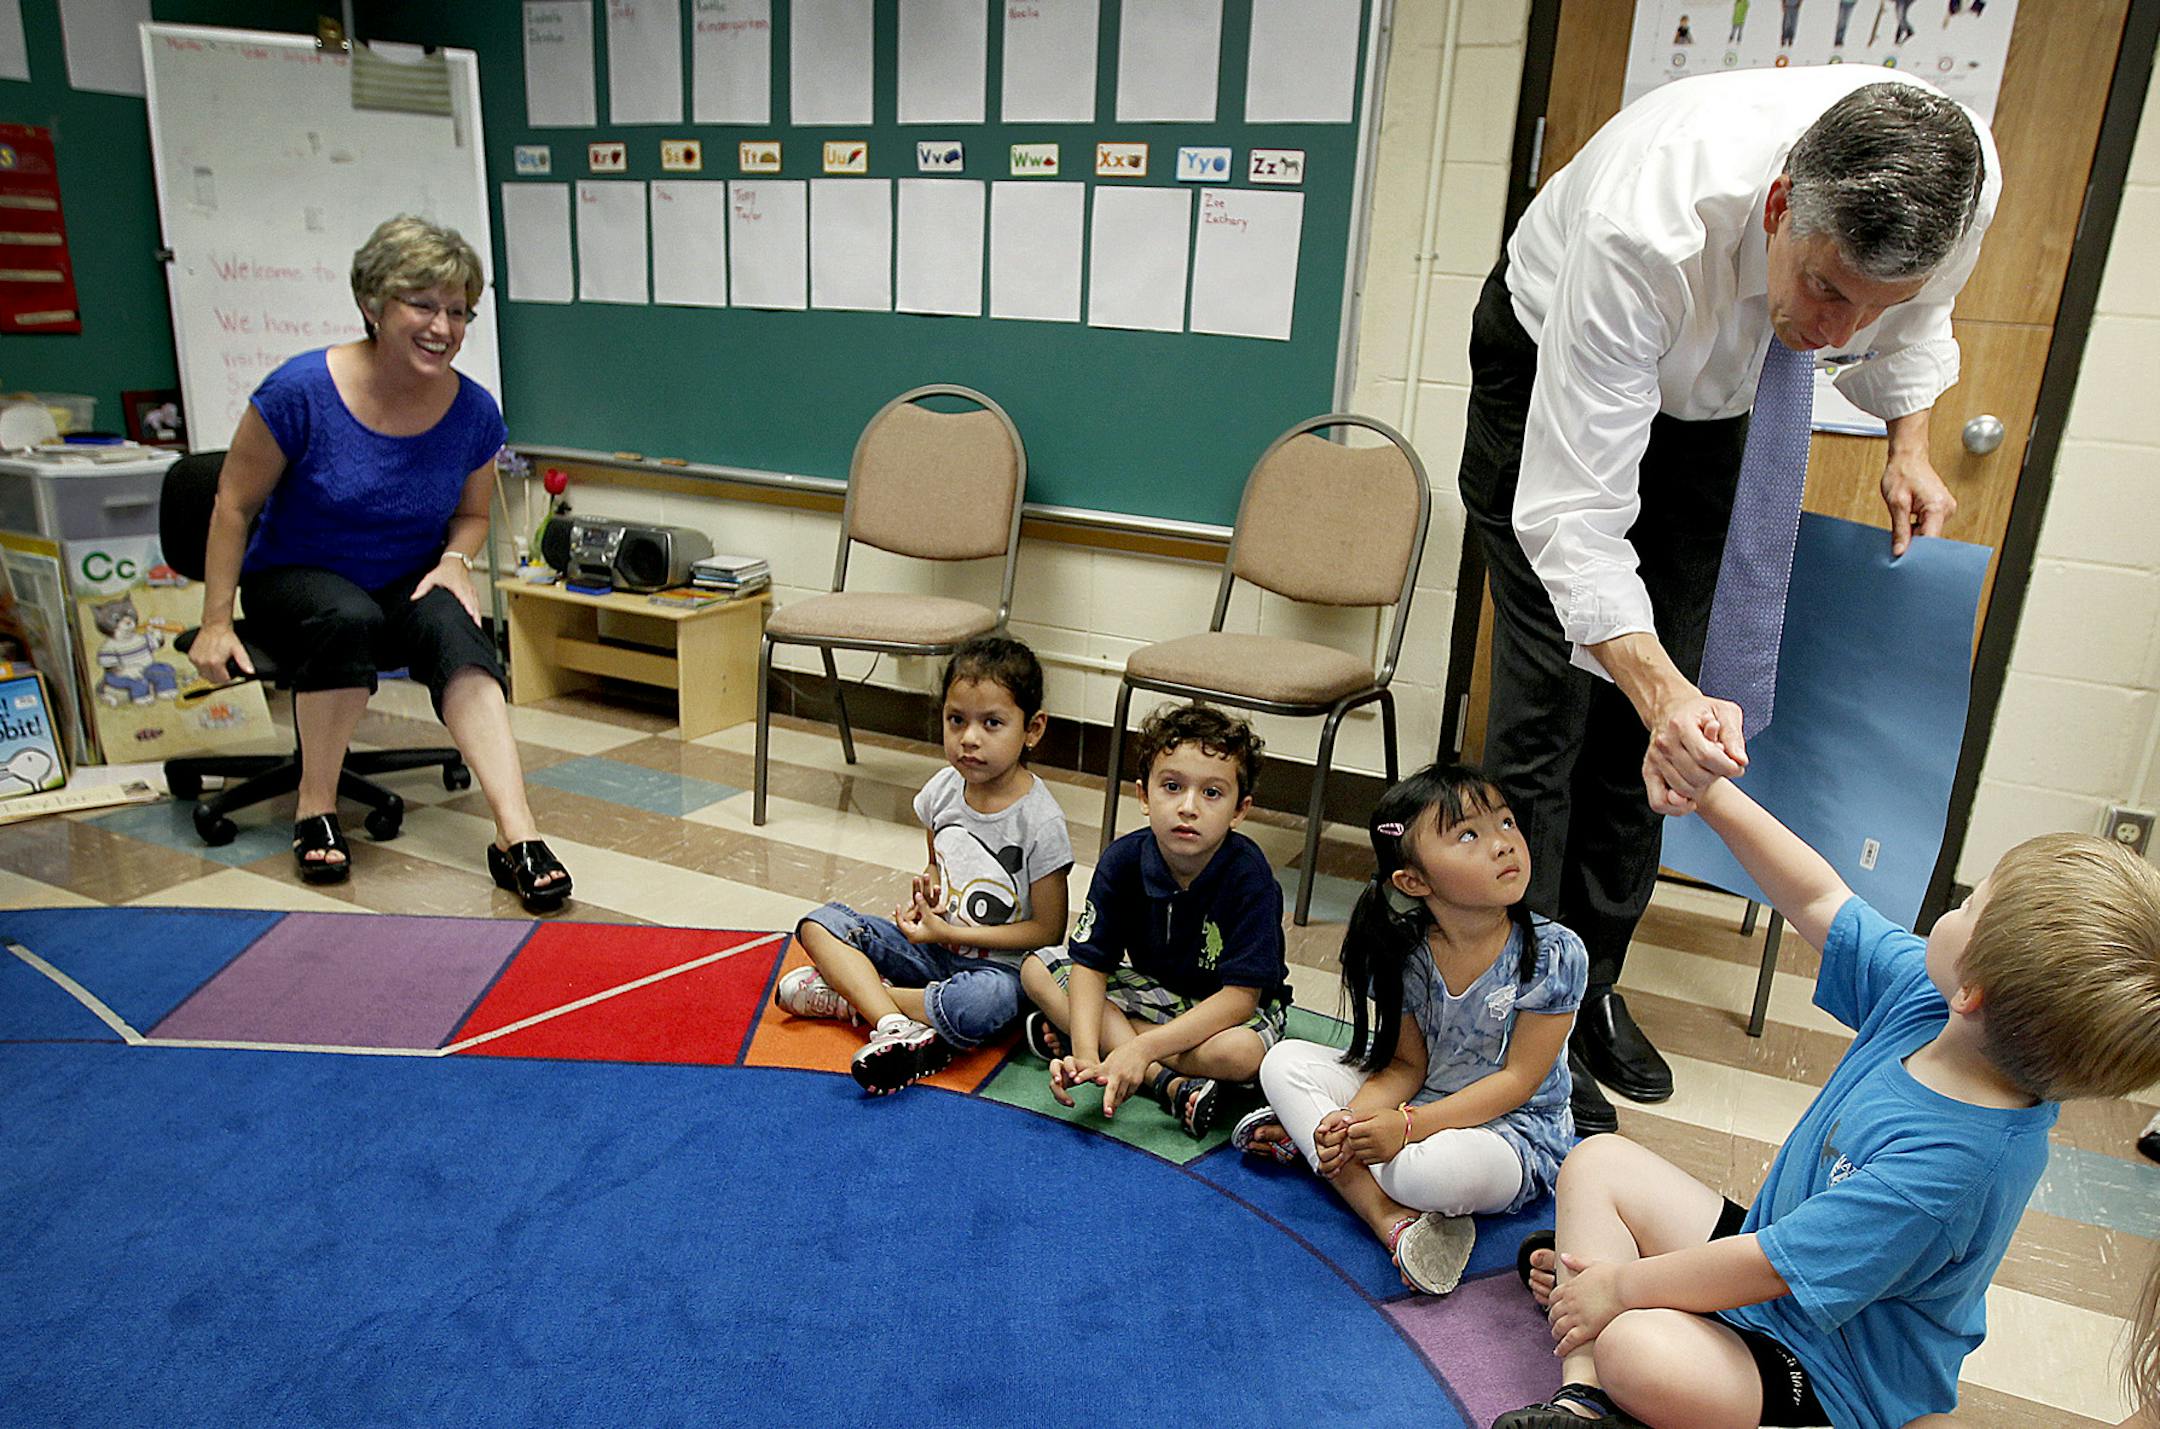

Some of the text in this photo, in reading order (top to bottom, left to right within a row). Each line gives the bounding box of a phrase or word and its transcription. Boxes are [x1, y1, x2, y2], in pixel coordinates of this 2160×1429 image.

[664, 148, 680, 163] Ss
[744, 149, 757, 164] Tt
[826, 149, 847, 164] Uu
[920, 150, 941, 164] Vv
[1013, 152, 1042, 167] Ww
[1099, 151, 1124, 167] Xx
[1186, 153, 1212, 174] Yy
[1252, 158, 1277, 175] Zz
[1204, 211, 1248, 233] Zachary
[208, 251, 336, 283] Welcome to
[213, 305, 253, 334] We
[263, 310, 313, 336] have
[82, 551, 136, 581] Cc
[1790, 1371, 1803, 1406] NAVY
